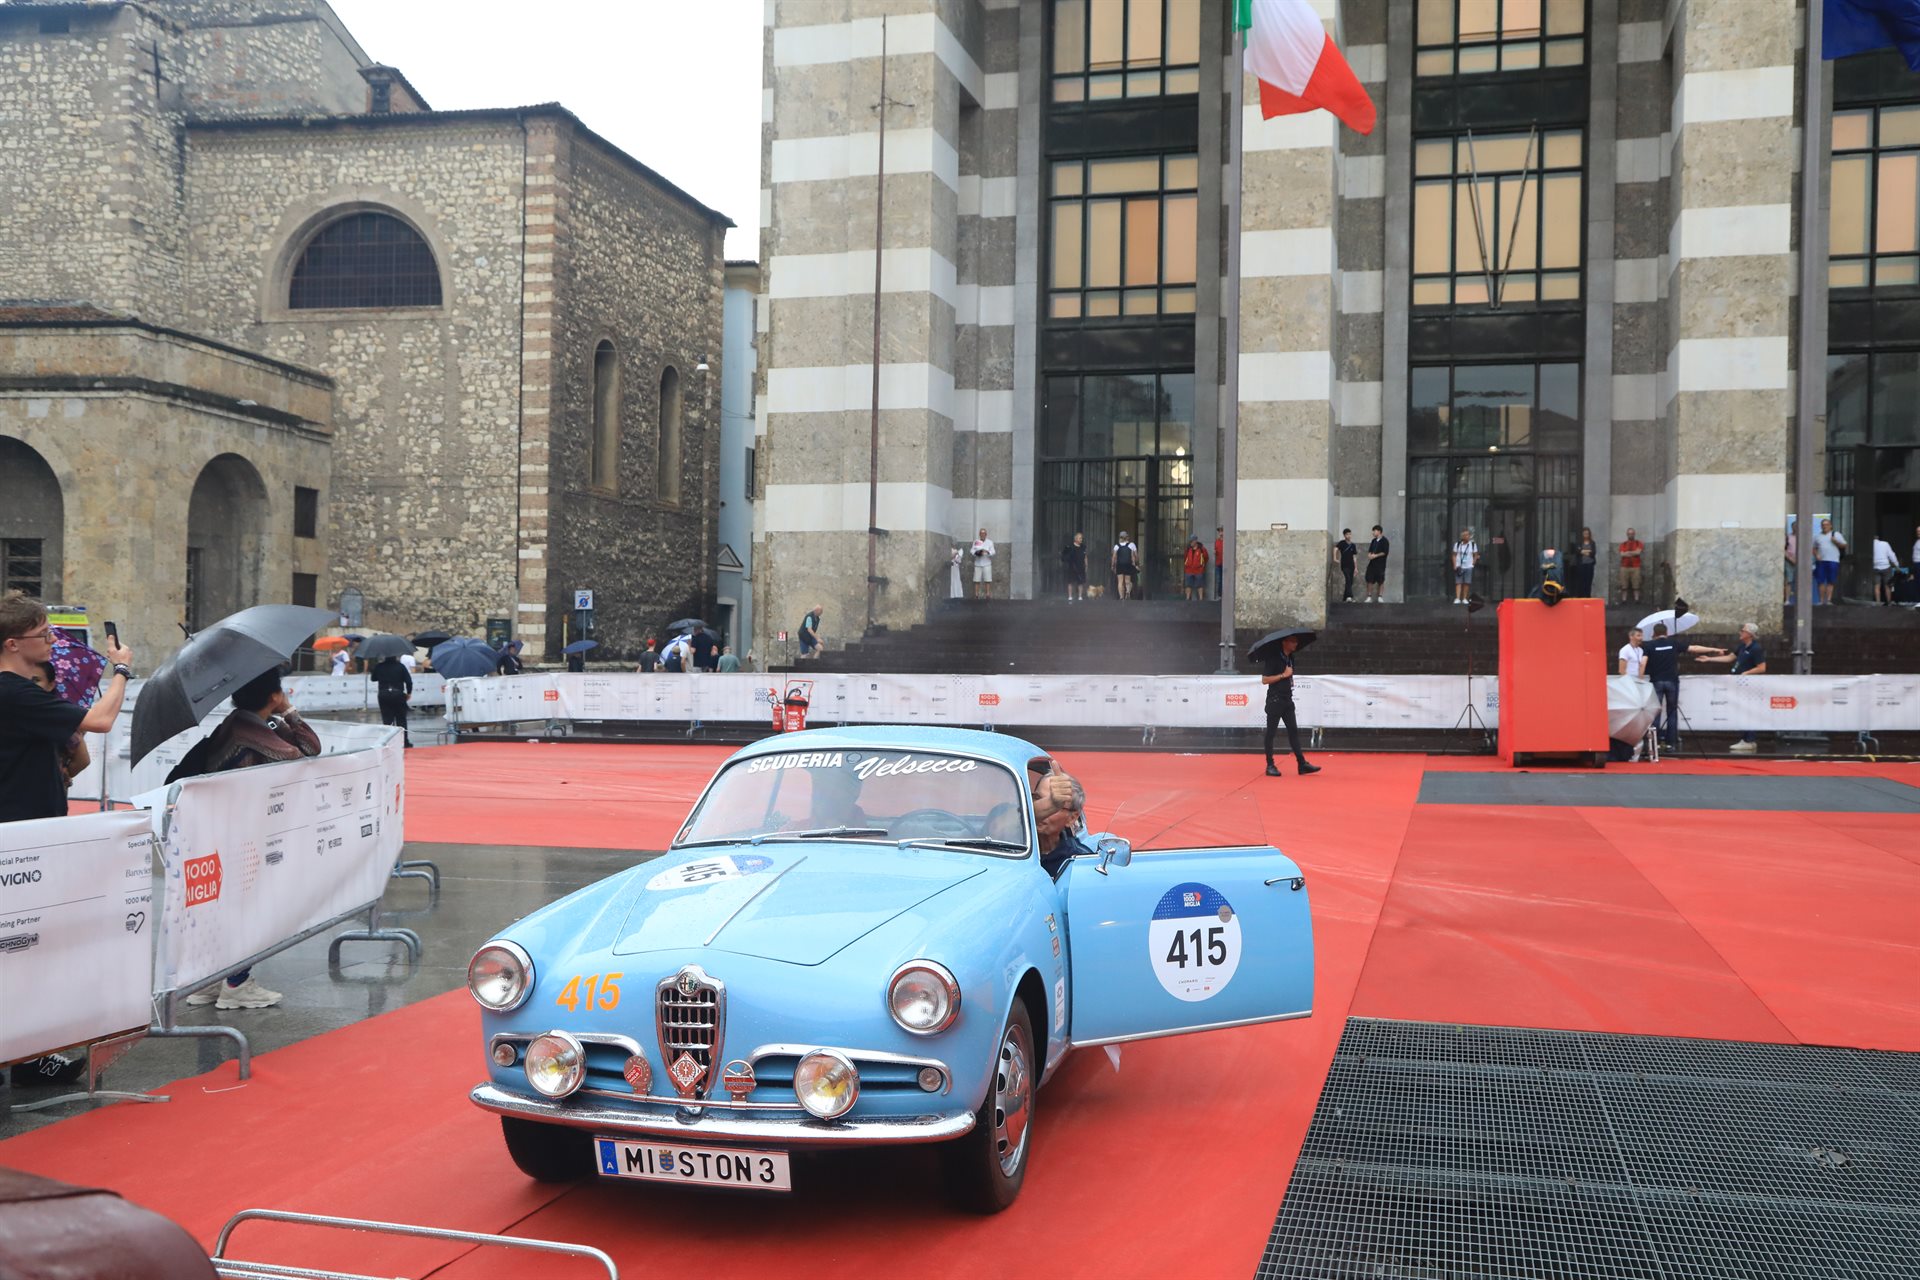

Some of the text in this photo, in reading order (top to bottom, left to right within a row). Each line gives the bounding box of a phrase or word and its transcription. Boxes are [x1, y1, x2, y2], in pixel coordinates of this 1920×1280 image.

[748, 753, 978, 780] SCUDERIA Velsecco
[15, 855, 40, 864] Partner
[187, 859, 216, 880] 1000
[16, 916, 41, 926] Partner
[1166, 926, 1227, 968] 415
[556, 972, 625, 1012] 415
[606, 1161, 615, 1170] A
[624, 1147, 775, 1184] MI STON 3
